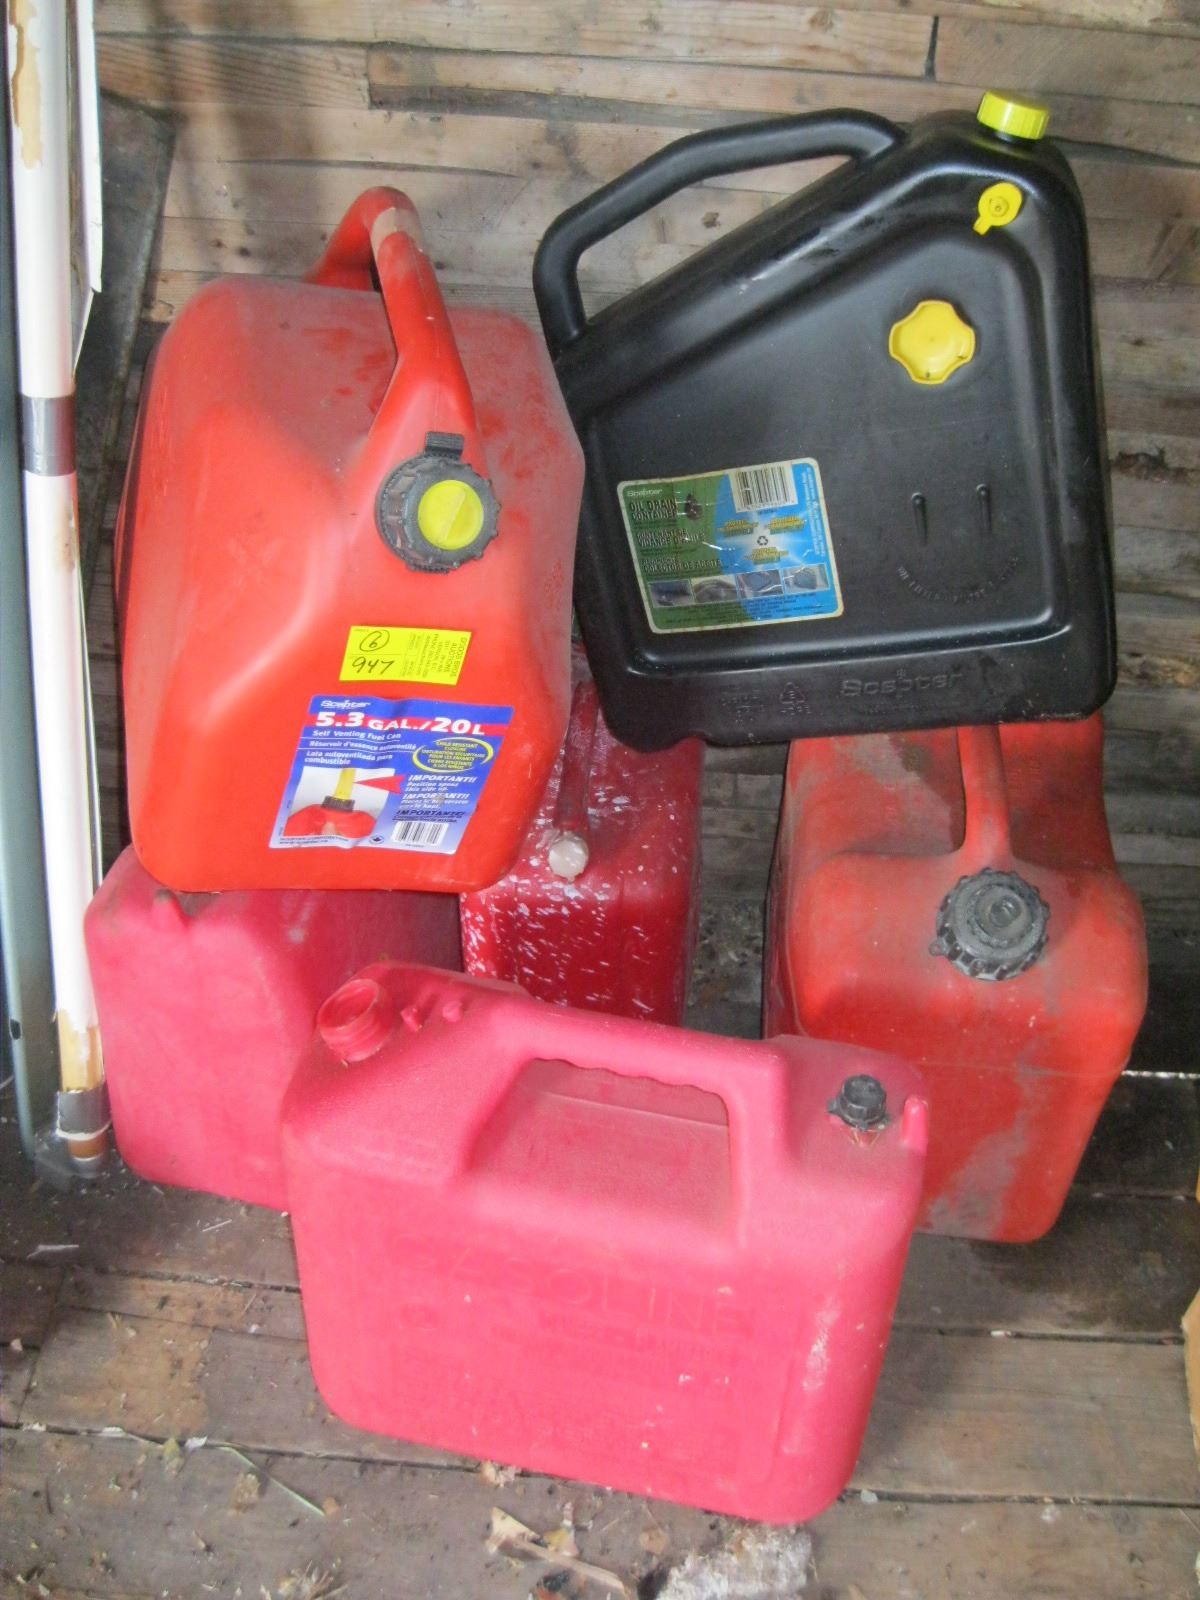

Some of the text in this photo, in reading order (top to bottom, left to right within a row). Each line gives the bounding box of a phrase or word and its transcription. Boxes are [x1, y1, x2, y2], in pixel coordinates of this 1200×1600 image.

[352, 656, 395, 675] 947
[320, 699, 371, 709] Scepter
[315, 711, 365, 727] 5.3
[312, 729, 402, 741] Self Venting Fuel Can
[304, 756, 352, 765] combustible
